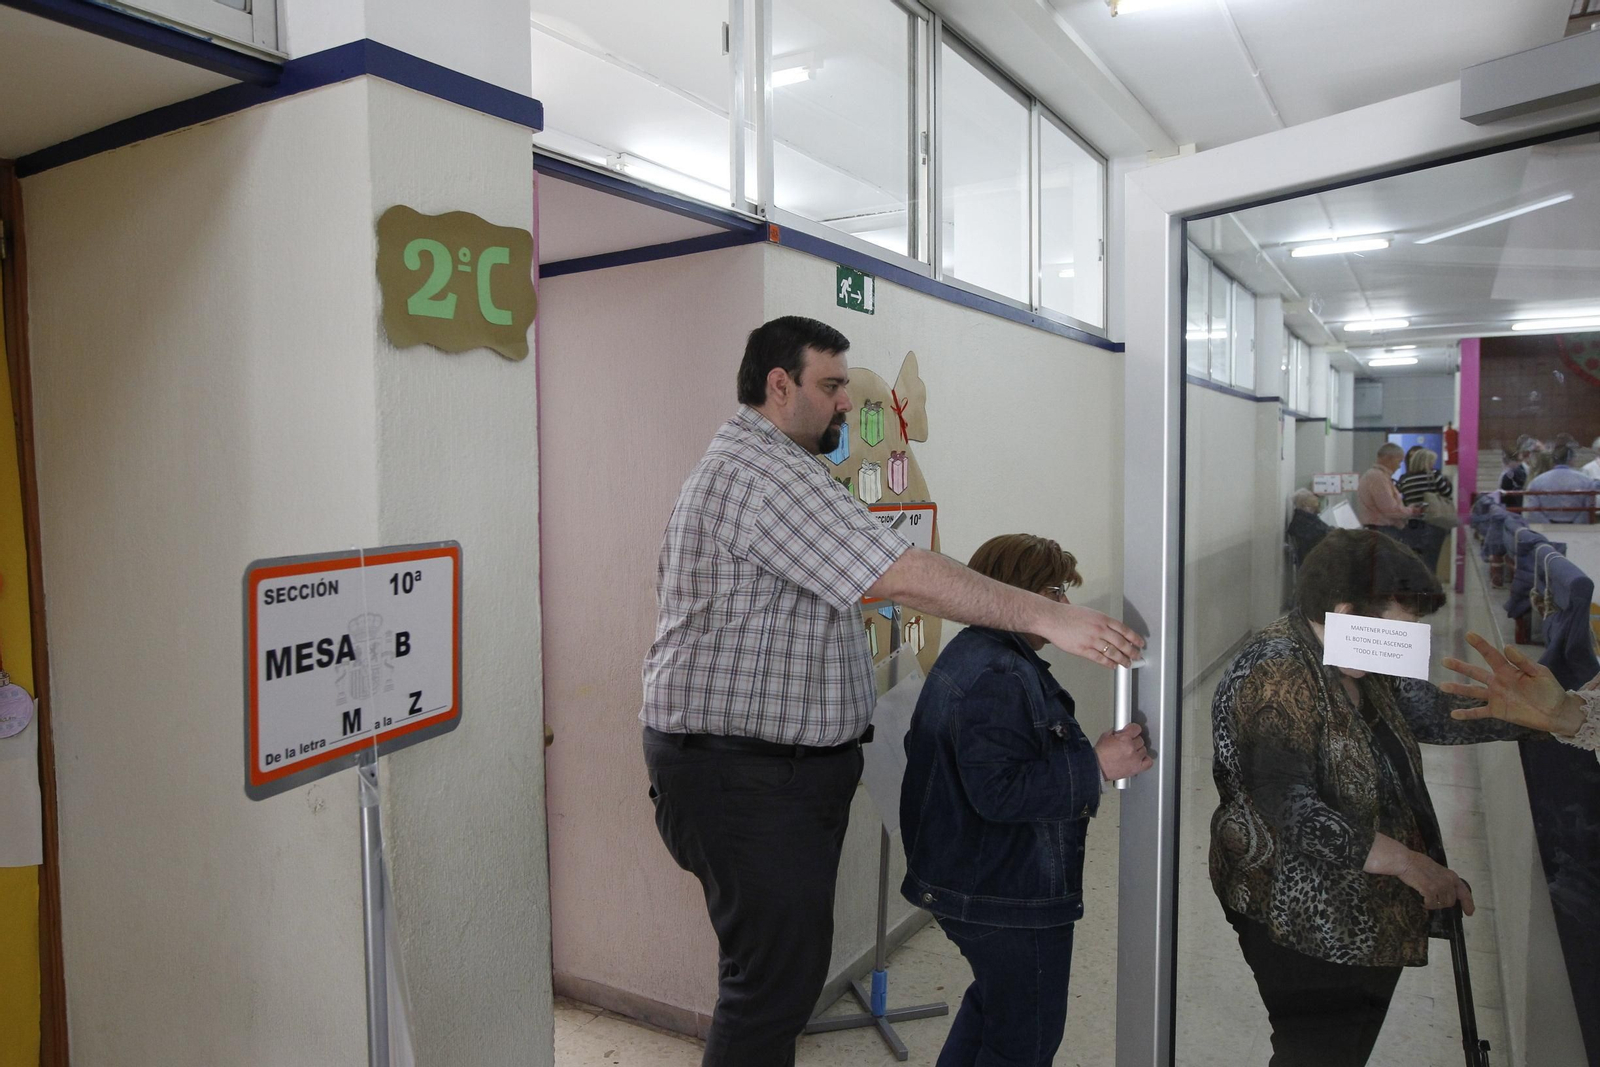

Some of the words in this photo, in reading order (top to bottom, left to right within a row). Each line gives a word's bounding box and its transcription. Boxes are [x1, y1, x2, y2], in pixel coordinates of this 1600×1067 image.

[264, 578, 339, 605] SECCIÓN
[389, 570, 422, 595] 10ª
[1350, 625, 1381, 633] MANTENER
[1382, 628, 1407, 636] PULSADO
[1352, 636, 1371, 644] BOTON
[1383, 640, 1412, 649] ASCENSOR
[265, 633, 357, 681] MESA
[395, 631, 411, 658] B
[265, 753, 281, 766] De
[285, 748, 296, 759] la
[299, 738, 327, 756] letra
[342, 707, 362, 737] M
[374, 720, 381, 730] a
[383, 716, 393, 727] la
[408, 690, 423, 716] Z
